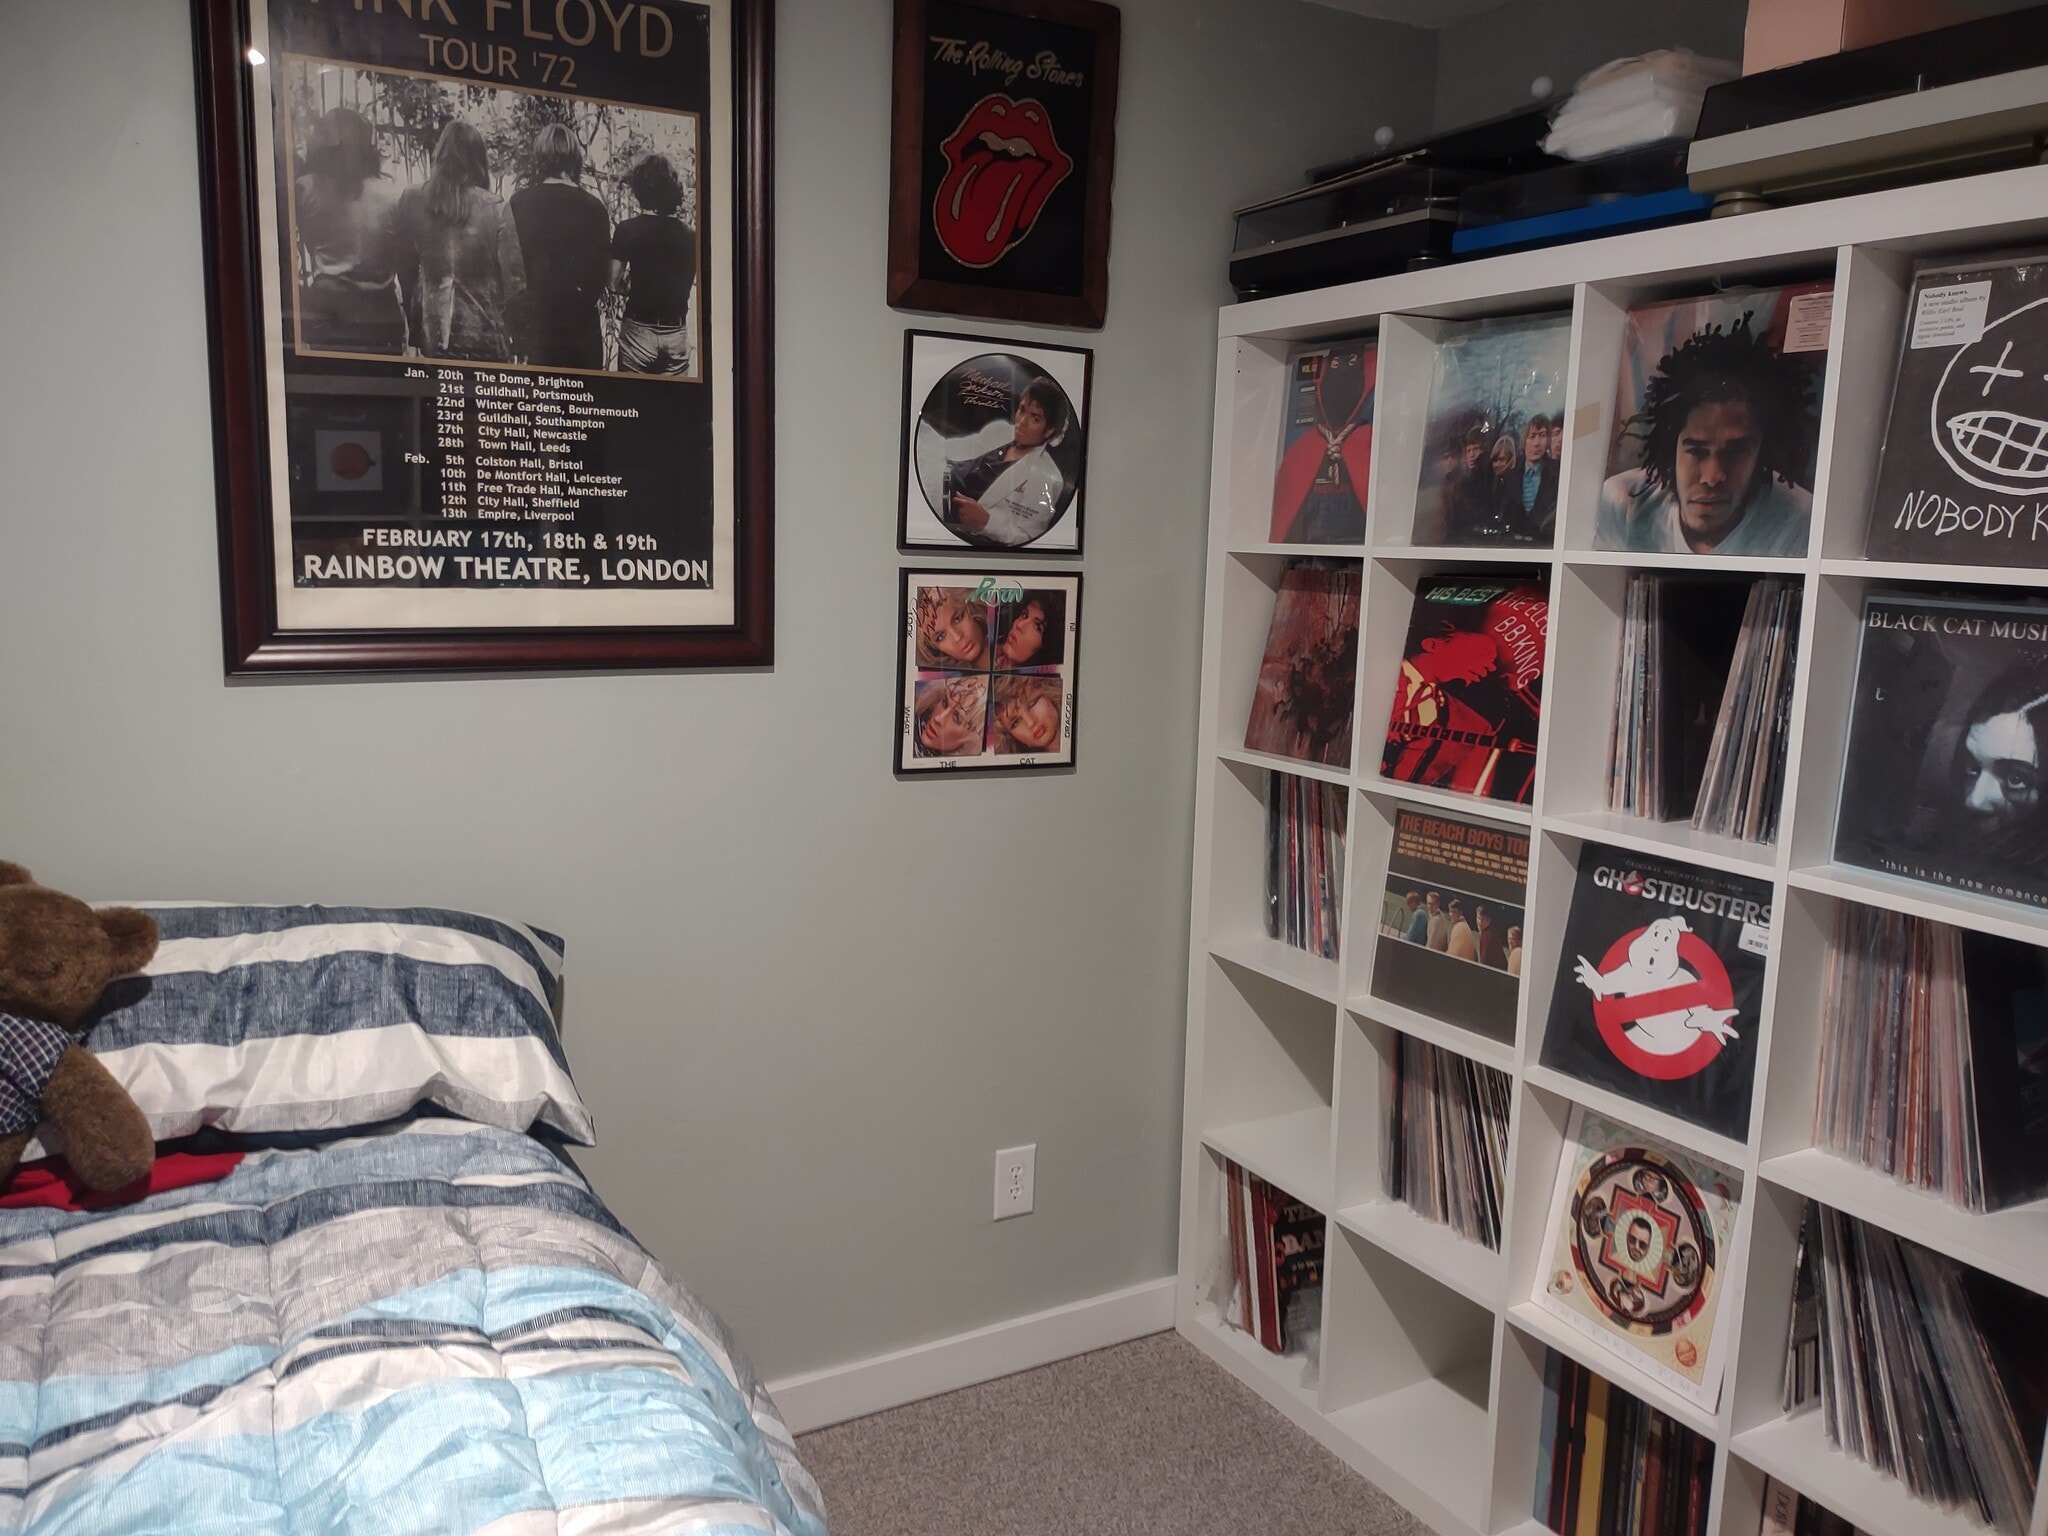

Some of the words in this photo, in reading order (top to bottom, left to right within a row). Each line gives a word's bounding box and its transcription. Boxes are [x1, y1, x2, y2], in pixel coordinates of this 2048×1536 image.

[419, 33, 519, 80] TOUR
[532, 51, 578, 88] '72
[930, 36, 967, 64] The
[965, 41, 1024, 86] Rolling
[1026, 50, 1084, 87] Stones
[404, 367, 429, 379] Jan.
[437, 369, 464, 381] 20th
[474, 371, 496, 383] The
[499, 373, 535, 387] Dome,
[538, 375, 584, 389] Brighton
[440, 383, 465, 395] 21st
[475, 385, 529, 400] Guildhall,
[533, 389, 594, 402] Portsmouth
[436, 396, 465, 408] 22nd
[475, 398, 514, 411] Winter
[517, 401, 565, 415] Gardens,
[569, 404, 639, 418] Bournemouth
[436, 410, 464, 421] 23rd
[478, 412, 532, 426] Guildhall,
[535, 415, 605, 430] Southampton
[437, 424, 464, 435] 27th
[478, 426, 501, 438] City
[504, 427, 529, 439] Hall,
[533, 429, 588, 441] Newcastle
[437, 437, 465, 448] 28th
[478, 439, 507, 450] Town
[511, 440, 536, 453] Hall,
[540, 442, 571, 453] Leeds
[404, 452, 430, 464] Feb.
[445, 454, 465, 465] 5th
[476, 456, 517, 467] Colston
[520, 458, 545, 470] Hall,
[549, 459, 583, 470] Bristol
[440, 468, 466, 479] 10th
[477, 469, 491, 479] De
[495, 470, 543, 481] Montfort
[546, 472, 570, 484] Hall,
[574, 473, 623, 484] Leicester
[441, 481, 467, 492] 11th
[477, 482, 503, 493] Free
[506, 483, 537, 494] Trade
[540, 485, 564, 497] Hall,
[568, 486, 628, 497] Manchester
[441, 495, 467, 505] 12th
[477, 496, 500, 508] City
[503, 497, 528, 508] Hall,
[532, 497, 580, 509] Sheffield
[442, 508, 467, 518] 13th
[478, 509, 520, 521] Empire,
[524, 510, 575, 522] Liverpool
[1894, 490, 2025, 538] NOBODY
[363, 528, 473, 548] FEBRUARY
[481, 531, 533, 552] 17th,
[542, 532, 586, 550] 18th
[593, 533, 608, 550] &
[615, 534, 657, 551] 19th
[304, 554, 445, 580] RAINBOW
[454, 556, 591, 585] THEATRE,
[601, 558, 708, 582] LONDON
[1425, 587, 1456, 600] HIS
[1454, 588, 1505, 603] BEST
[1496, 591, 1534, 611] THE
[1869, 611, 1937, 632] BLACK
[1943, 617, 1985, 636] CAT
[1020, 757, 1036, 765] CAT
[1400, 814, 1421, 832] THE
[1422, 818, 1465, 843] BEACH
[1467, 828, 1504, 851] BOYS
[1933, 870, 1952, 883] the
[1959, 878, 1983, 890] new
